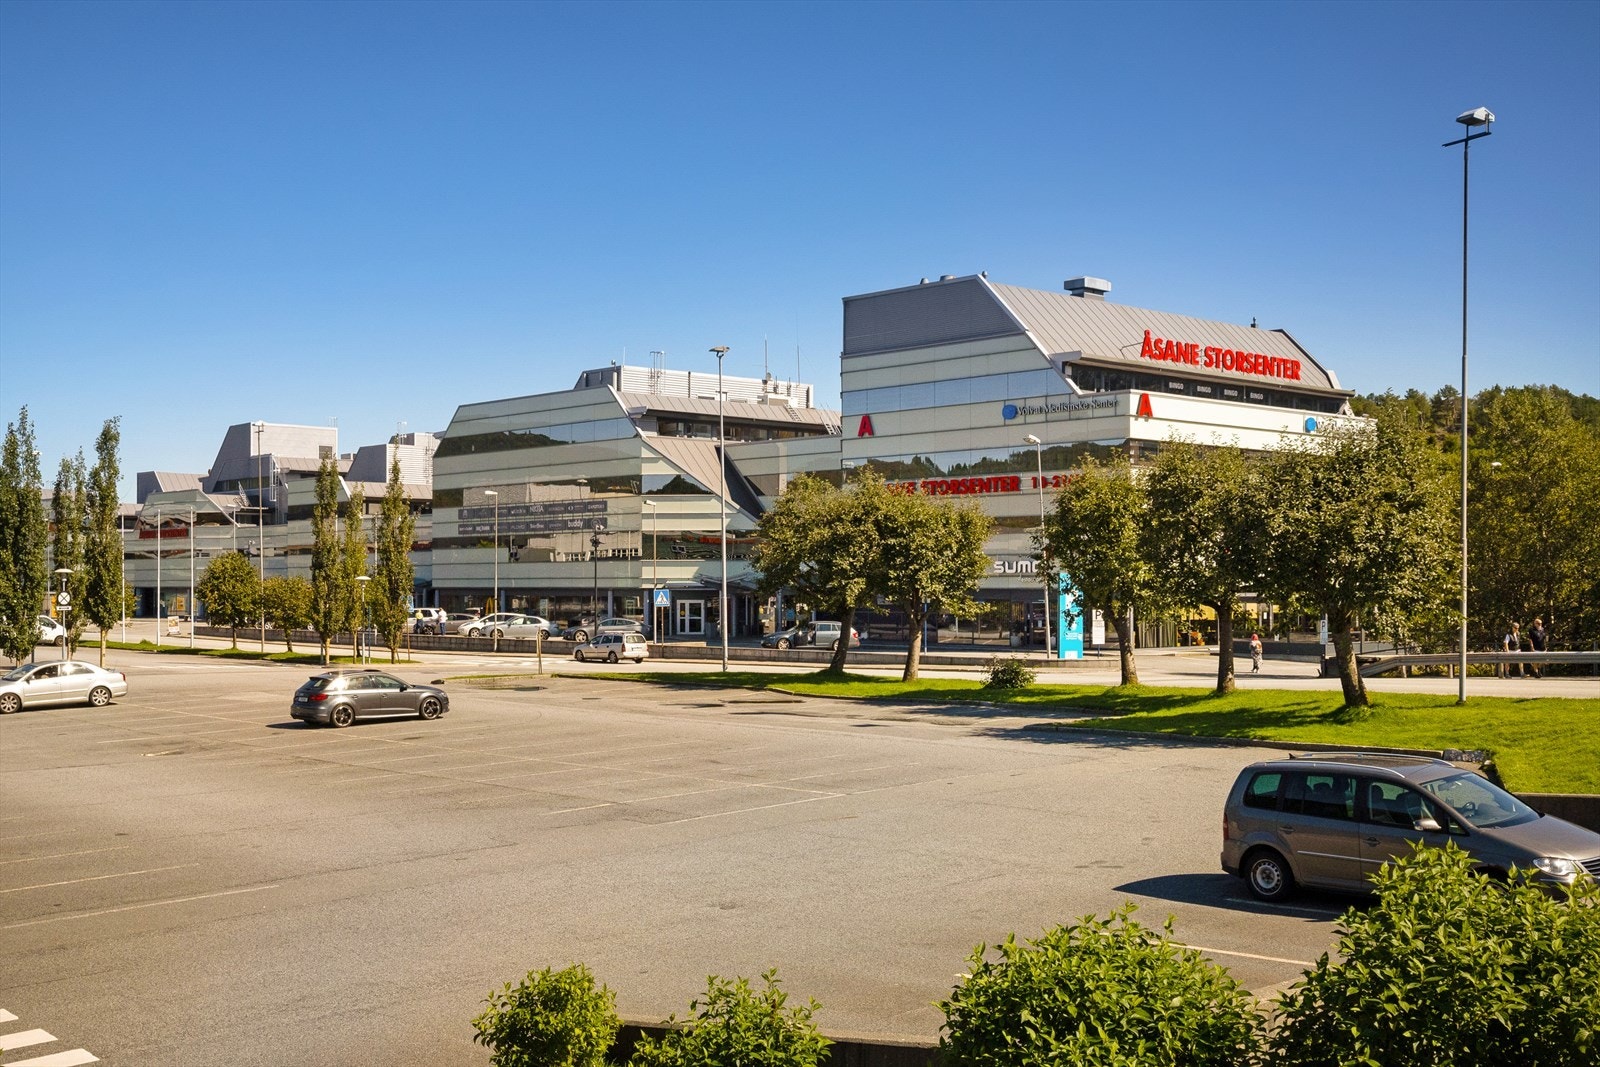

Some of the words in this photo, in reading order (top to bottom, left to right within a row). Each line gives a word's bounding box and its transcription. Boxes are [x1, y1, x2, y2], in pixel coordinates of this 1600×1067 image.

[1141, 329, 1199, 365] ÅSANE
[1204, 346, 1301, 380] STORSENTER
[1169, 382, 1184, 390] BINGO
[1197, 385, 1212, 394] BINGO
[1224, 388, 1239, 397] BINGO
[1250, 392, 1264, 400] BINGO
[1044, 400, 1090, 414] Medisinske
[1092, 398, 1120, 410] Senter
[1136, 393, 1153, 420] A
[857, 414, 874, 437] A
[920, 475, 1020, 496] STORSENTER
[567, 518, 584, 529] buddy
